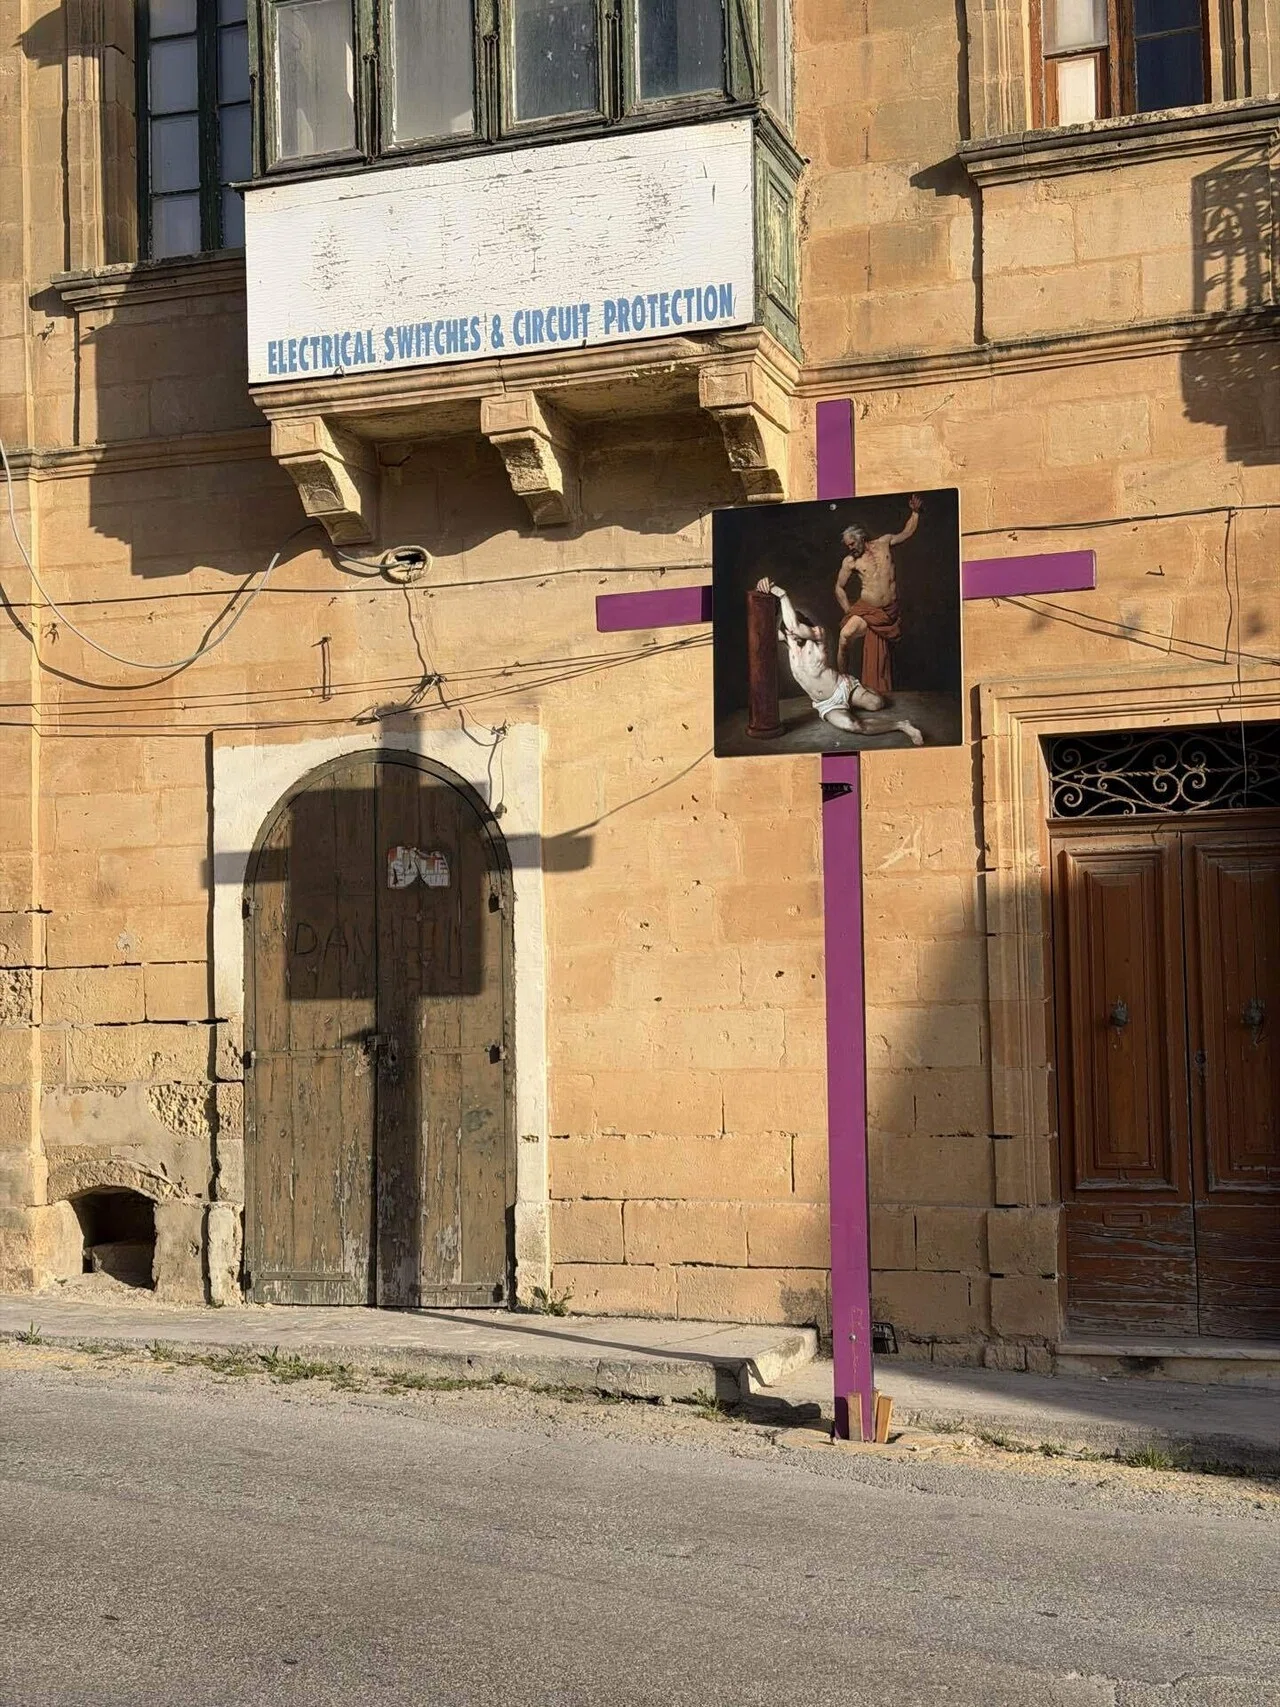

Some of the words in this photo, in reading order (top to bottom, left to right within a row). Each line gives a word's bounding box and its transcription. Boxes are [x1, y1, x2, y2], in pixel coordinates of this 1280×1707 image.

[267, 328, 376, 374] ELECTRICAL
[384, 317, 482, 362] SWITCHES
[491, 318, 504, 349] &
[513, 303, 591, 345] CIRCUIT
[604, 283, 734, 335] PROTECTION
